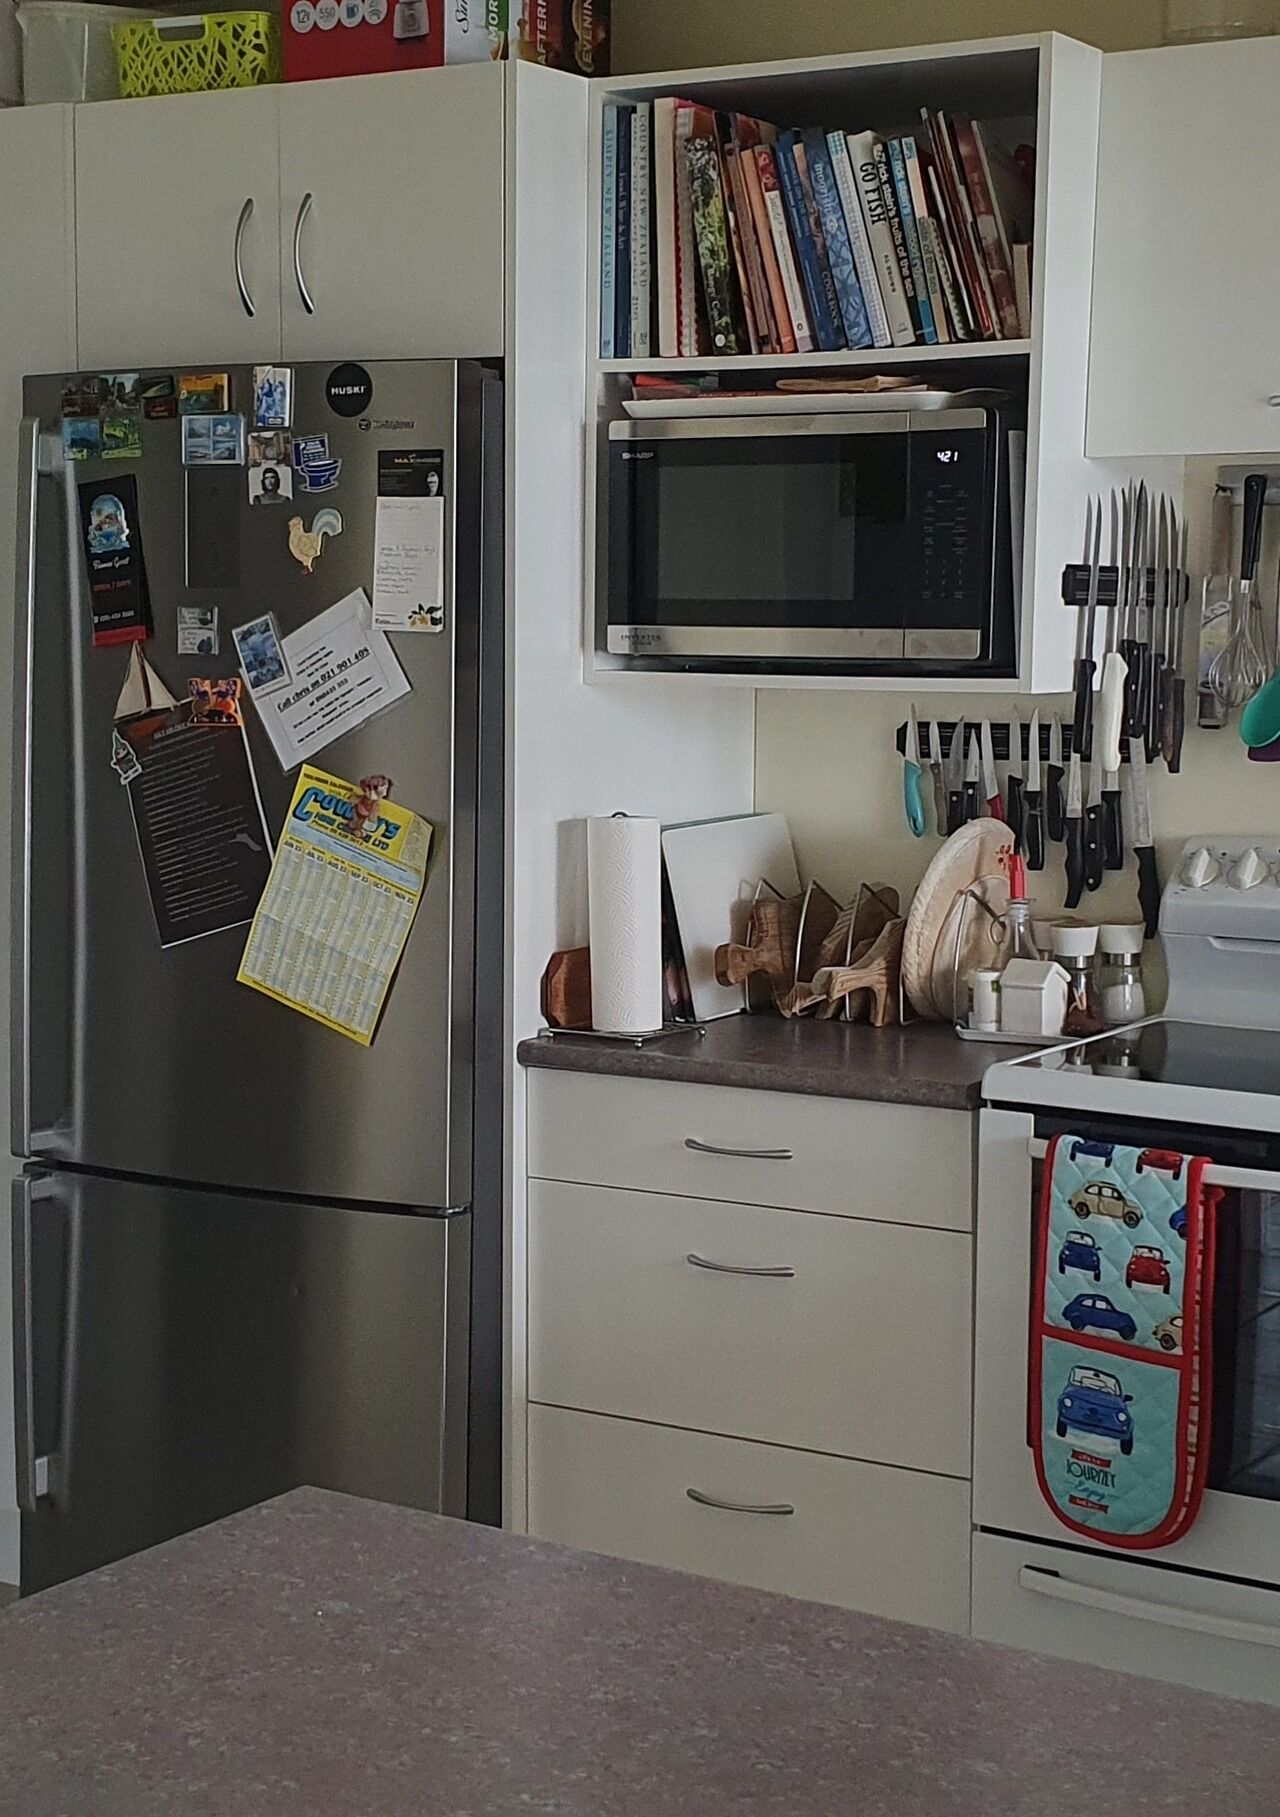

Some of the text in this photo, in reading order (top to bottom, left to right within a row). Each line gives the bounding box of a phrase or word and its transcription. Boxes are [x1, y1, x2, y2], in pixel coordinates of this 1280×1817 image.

[488, 0, 499, 41] MOR
[582, 0, 593, 63] EVENIN
[638, 114, 646, 179] COUNTRY
[604, 187, 612, 215] NEW
[858, 160, 887, 225] GO FISH
[603, 224, 611, 289] ZEALAND
[639, 224, 647, 288] ZEALAND
[876, 162, 914, 297] rick stein's fruits of the sea
[331, 386, 366, 395] HUSKI
[293, 786, 401, 840] COWYS
